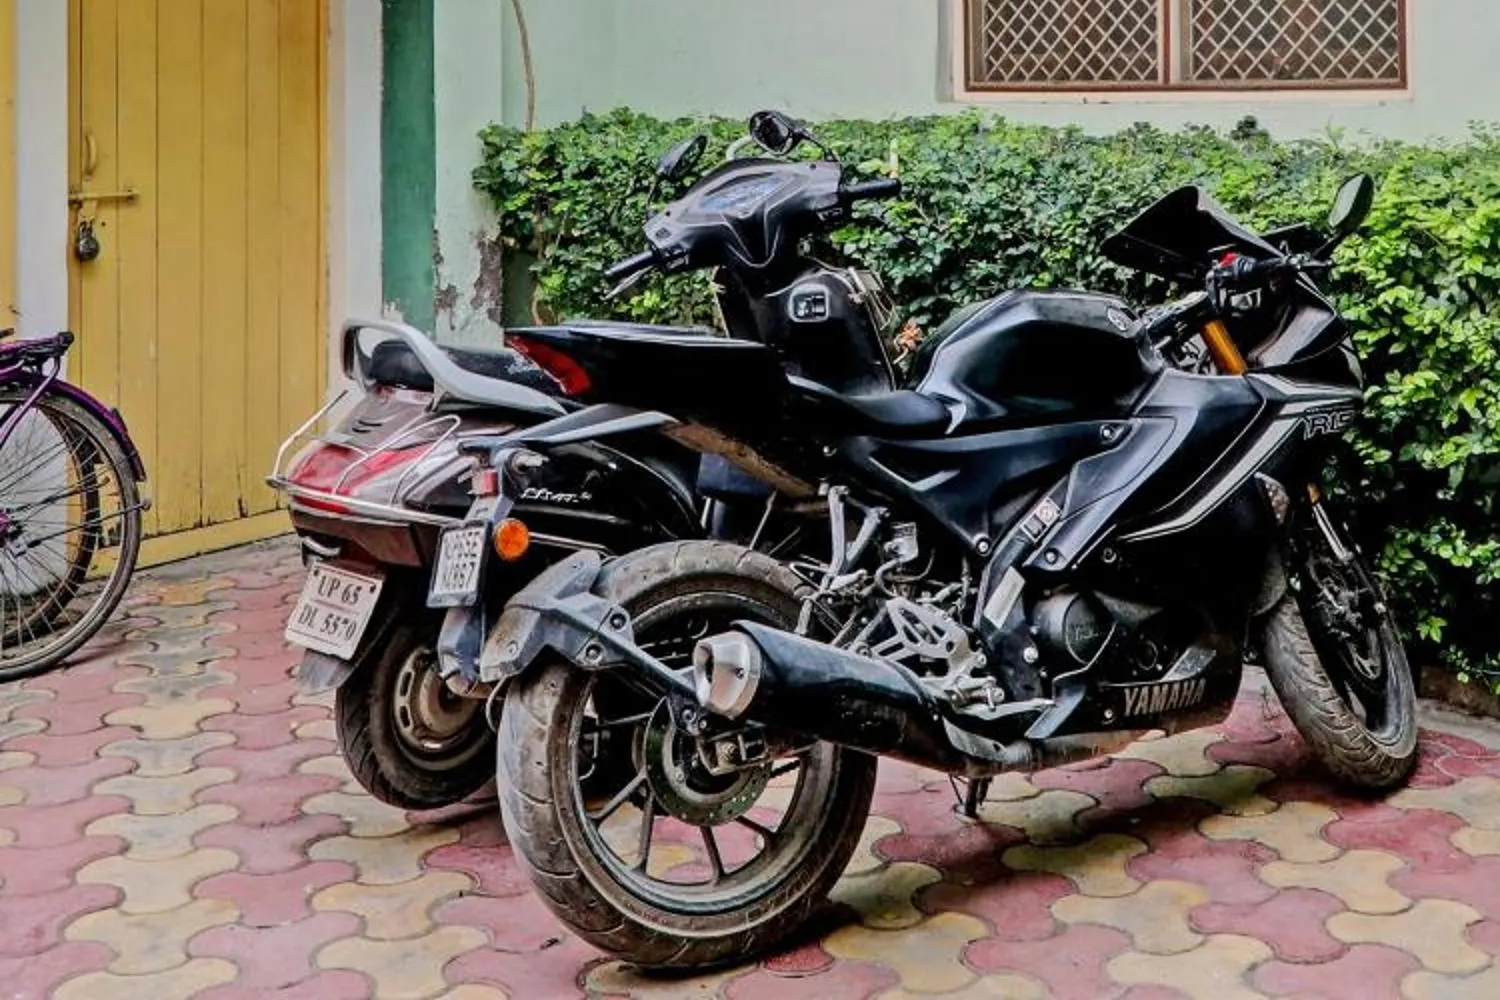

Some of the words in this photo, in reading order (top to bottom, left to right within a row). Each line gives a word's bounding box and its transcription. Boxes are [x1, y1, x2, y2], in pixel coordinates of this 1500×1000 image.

[317, 574, 342, 598] UP
[341, 583, 363, 605] 65
[1123, 678, 1206, 716] YAMAHA
